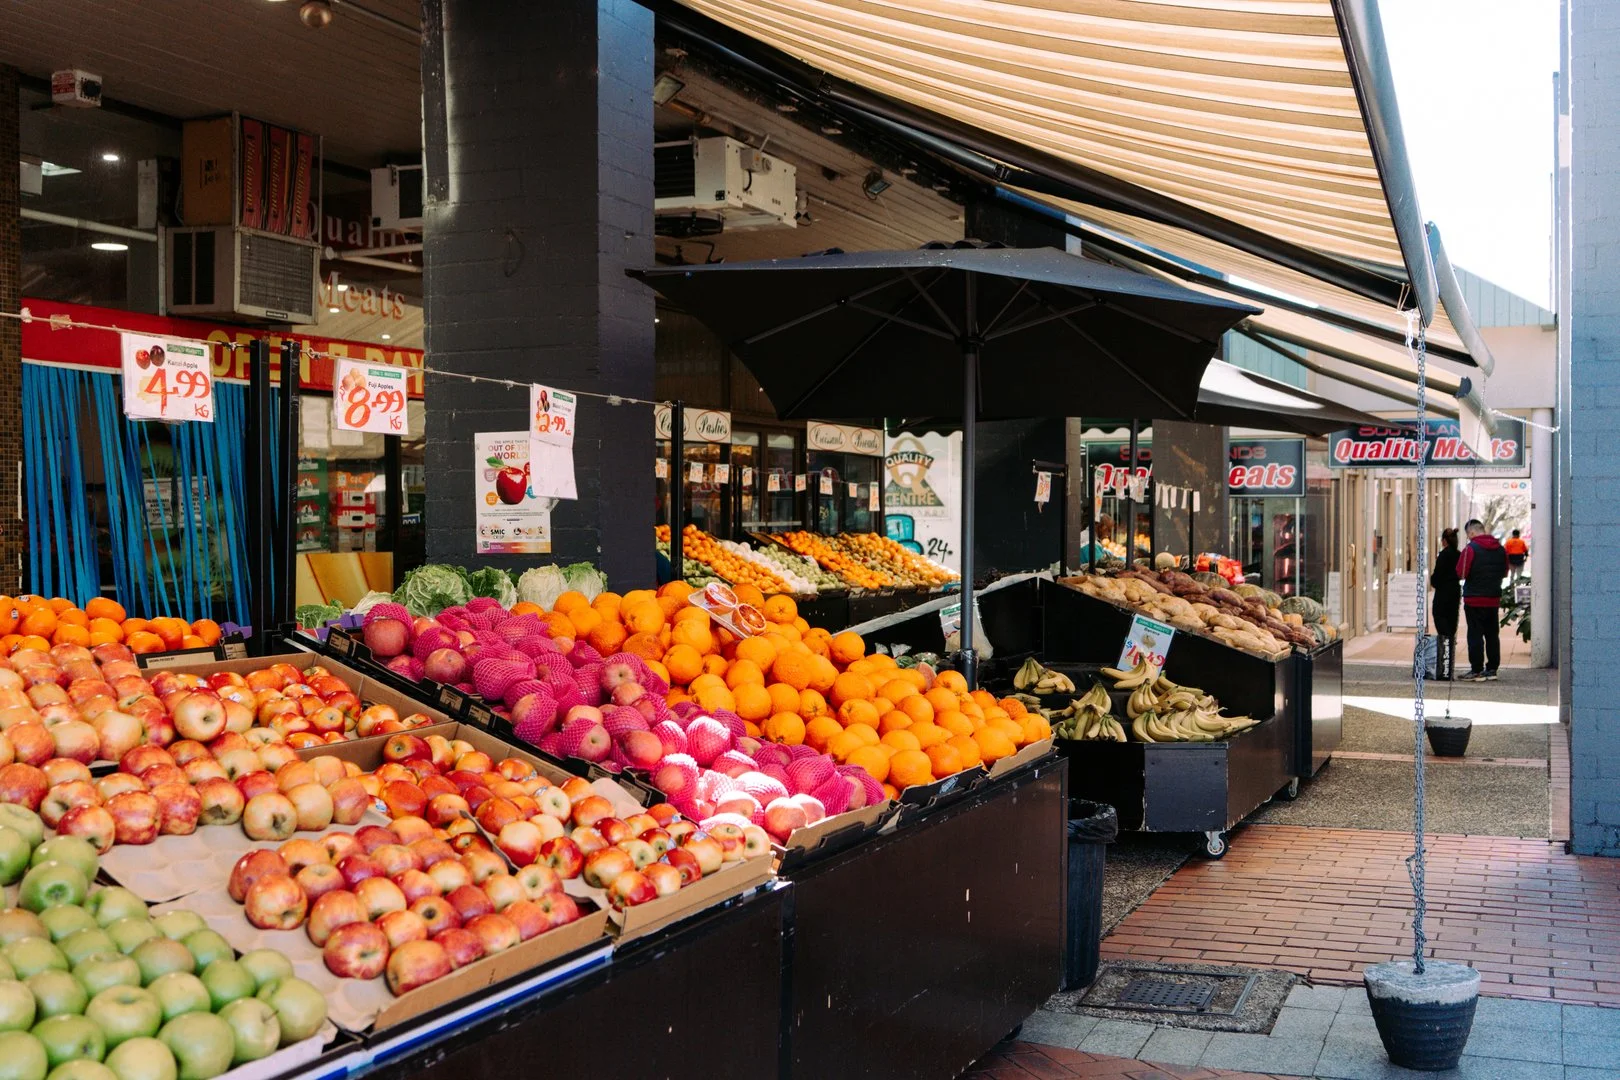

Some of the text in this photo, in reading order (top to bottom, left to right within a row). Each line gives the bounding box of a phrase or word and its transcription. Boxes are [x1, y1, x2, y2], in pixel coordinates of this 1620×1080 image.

[318, 270, 406, 319] Meats
[144, 368, 211, 416] 4.99
[368, 381, 377, 389] Fuji
[699, 415, 728, 435] Pasties
[494, 452, 528, 460] WORLD
[885, 452, 932, 467] QUALITY
[1334, 437, 1518, 463] Quality Mets
[1229, 463, 1295, 489] eats
[885, 492, 936, 506] CENTRE
